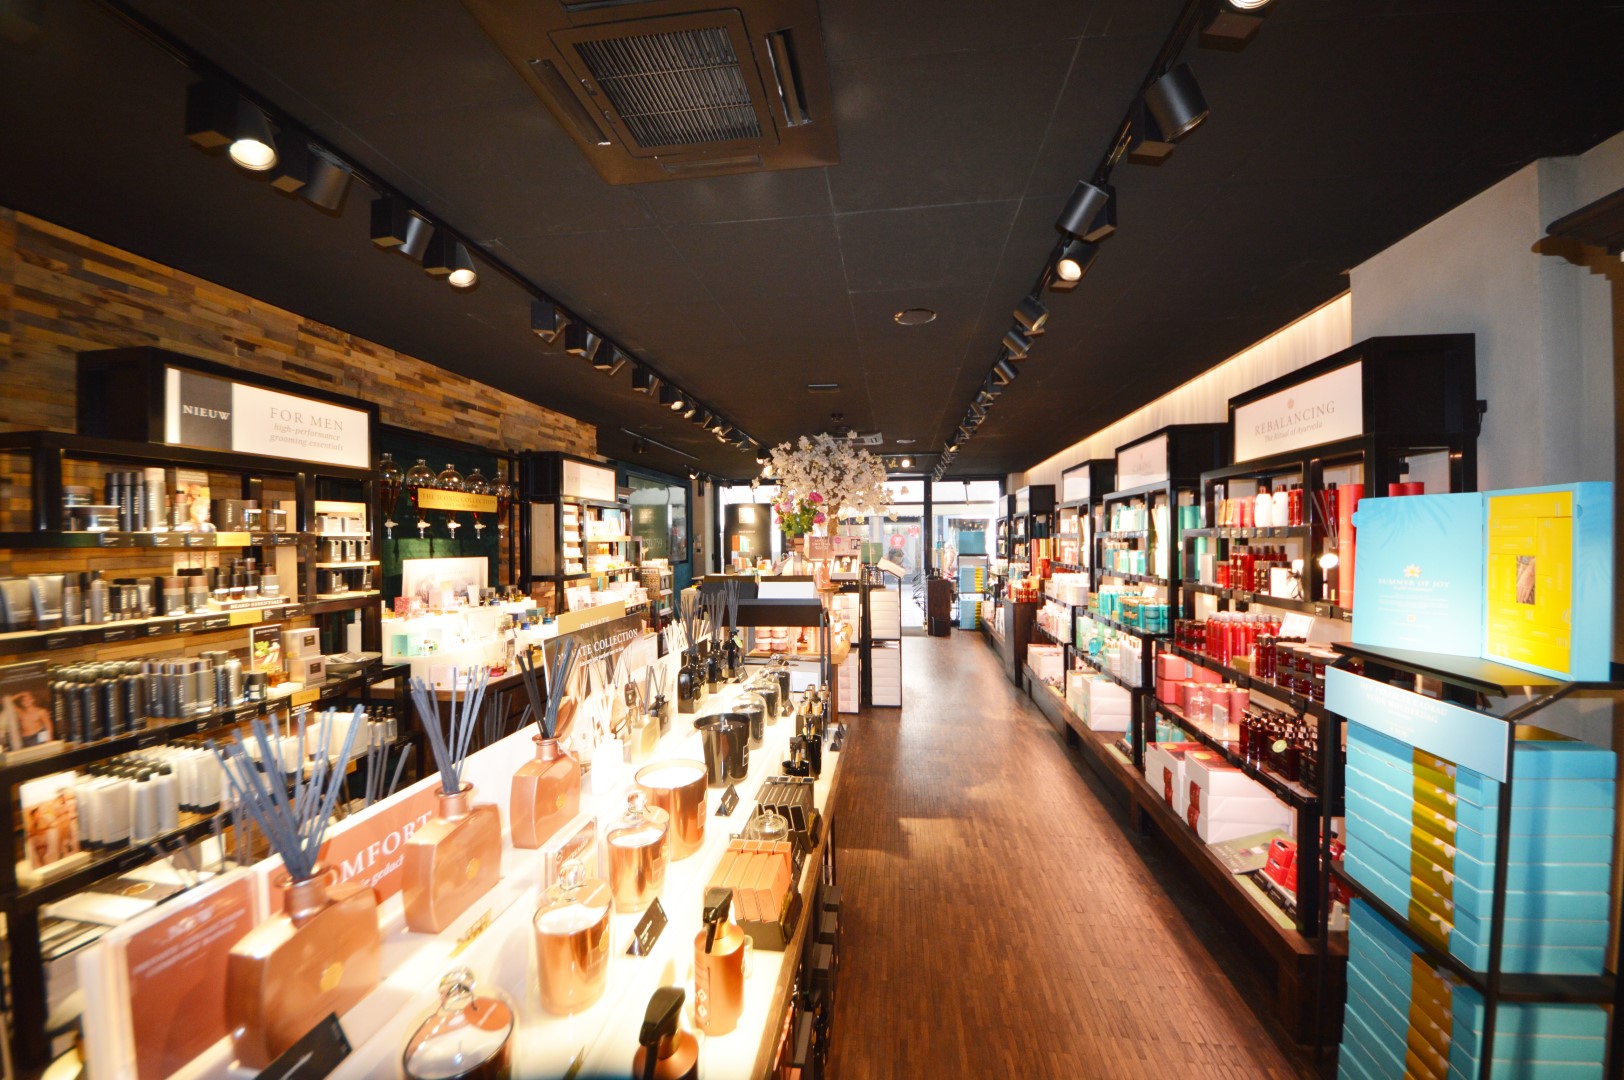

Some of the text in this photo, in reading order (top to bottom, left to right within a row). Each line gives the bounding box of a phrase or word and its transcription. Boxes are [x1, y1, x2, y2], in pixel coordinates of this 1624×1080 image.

[182, 404, 231, 421] NIEUW
[270, 407, 344, 432] FOR MEN
[1255, 401, 1335, 436] REBALANCING
[273, 422, 341, 441] high-performance
[1274, 429, 1290, 440] Ritual
[270, 434, 344, 451] grooming essentials
[460, 496, 497, 505] COLLECTION
[251, 599, 283, 607] ESSENTIALS
[593, 627, 638, 652] COLLECTION
